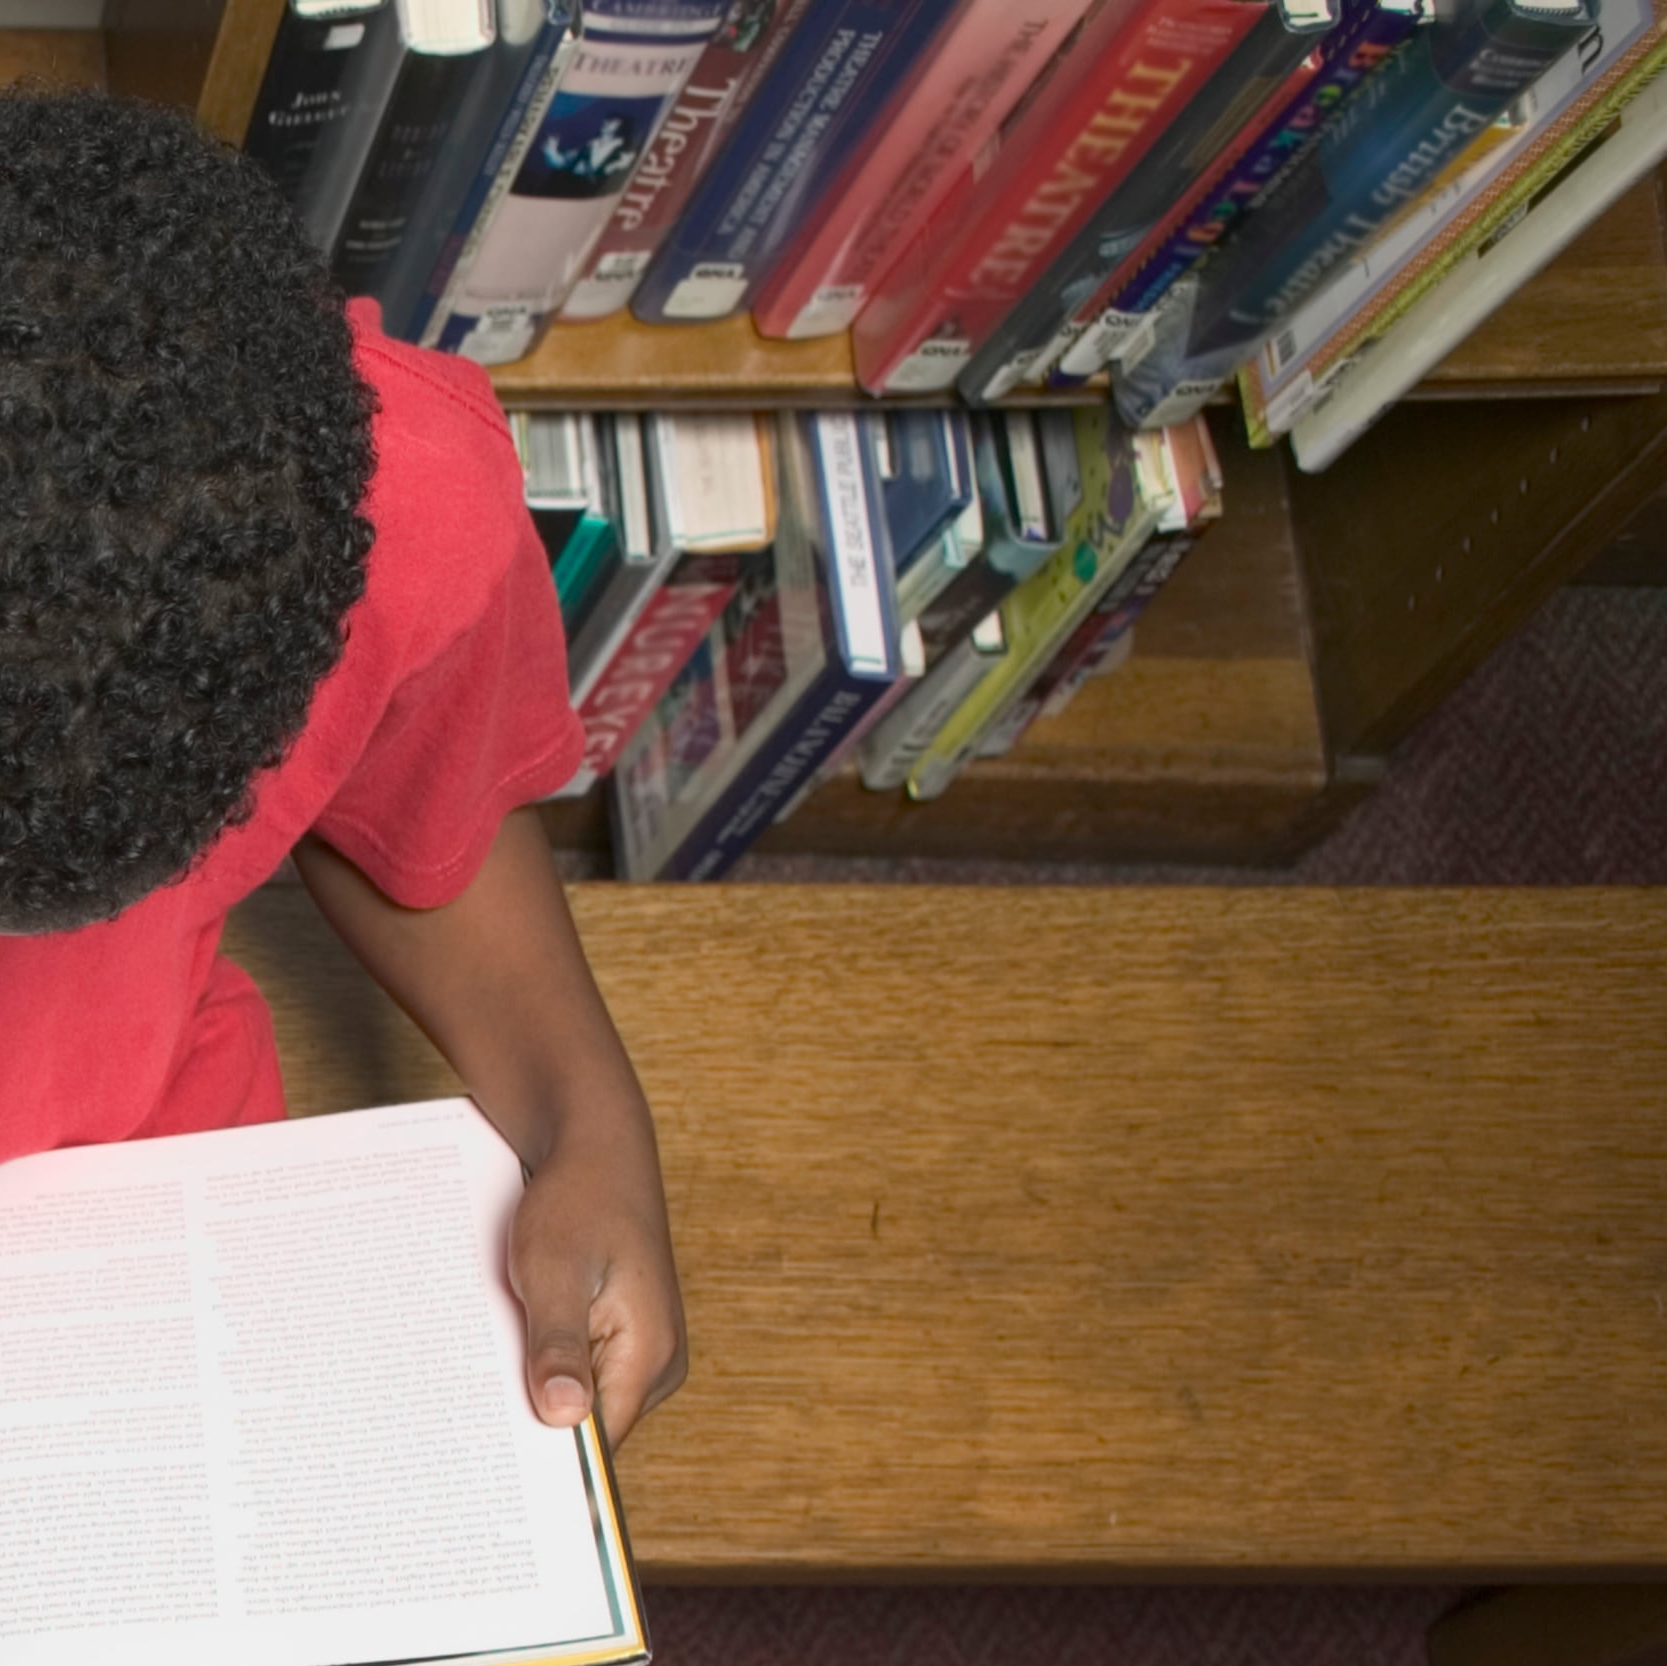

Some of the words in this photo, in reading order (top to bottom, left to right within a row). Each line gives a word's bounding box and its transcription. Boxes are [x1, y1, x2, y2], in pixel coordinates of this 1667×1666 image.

[575, 52, 695, 76] THEATRE
[816, 32, 883, 109] THEATRE
[1005, 17, 1051, 55] THE
[771, 29, 857, 141] PRODUCTION
[616, 76, 739, 232] Theatre
[746, 113, 831, 226] MANAGEMENT
[758, 145, 786, 162] IN
[962, 53, 1194, 289] THEATRE
[1363, 99, 1491, 214] British
[712, 167, 772, 238] AMERICA
[1254, 212, 1378, 325] Theatre
[831, 476, 870, 553] SEATTLE
[843, 551, 870, 590] THE
